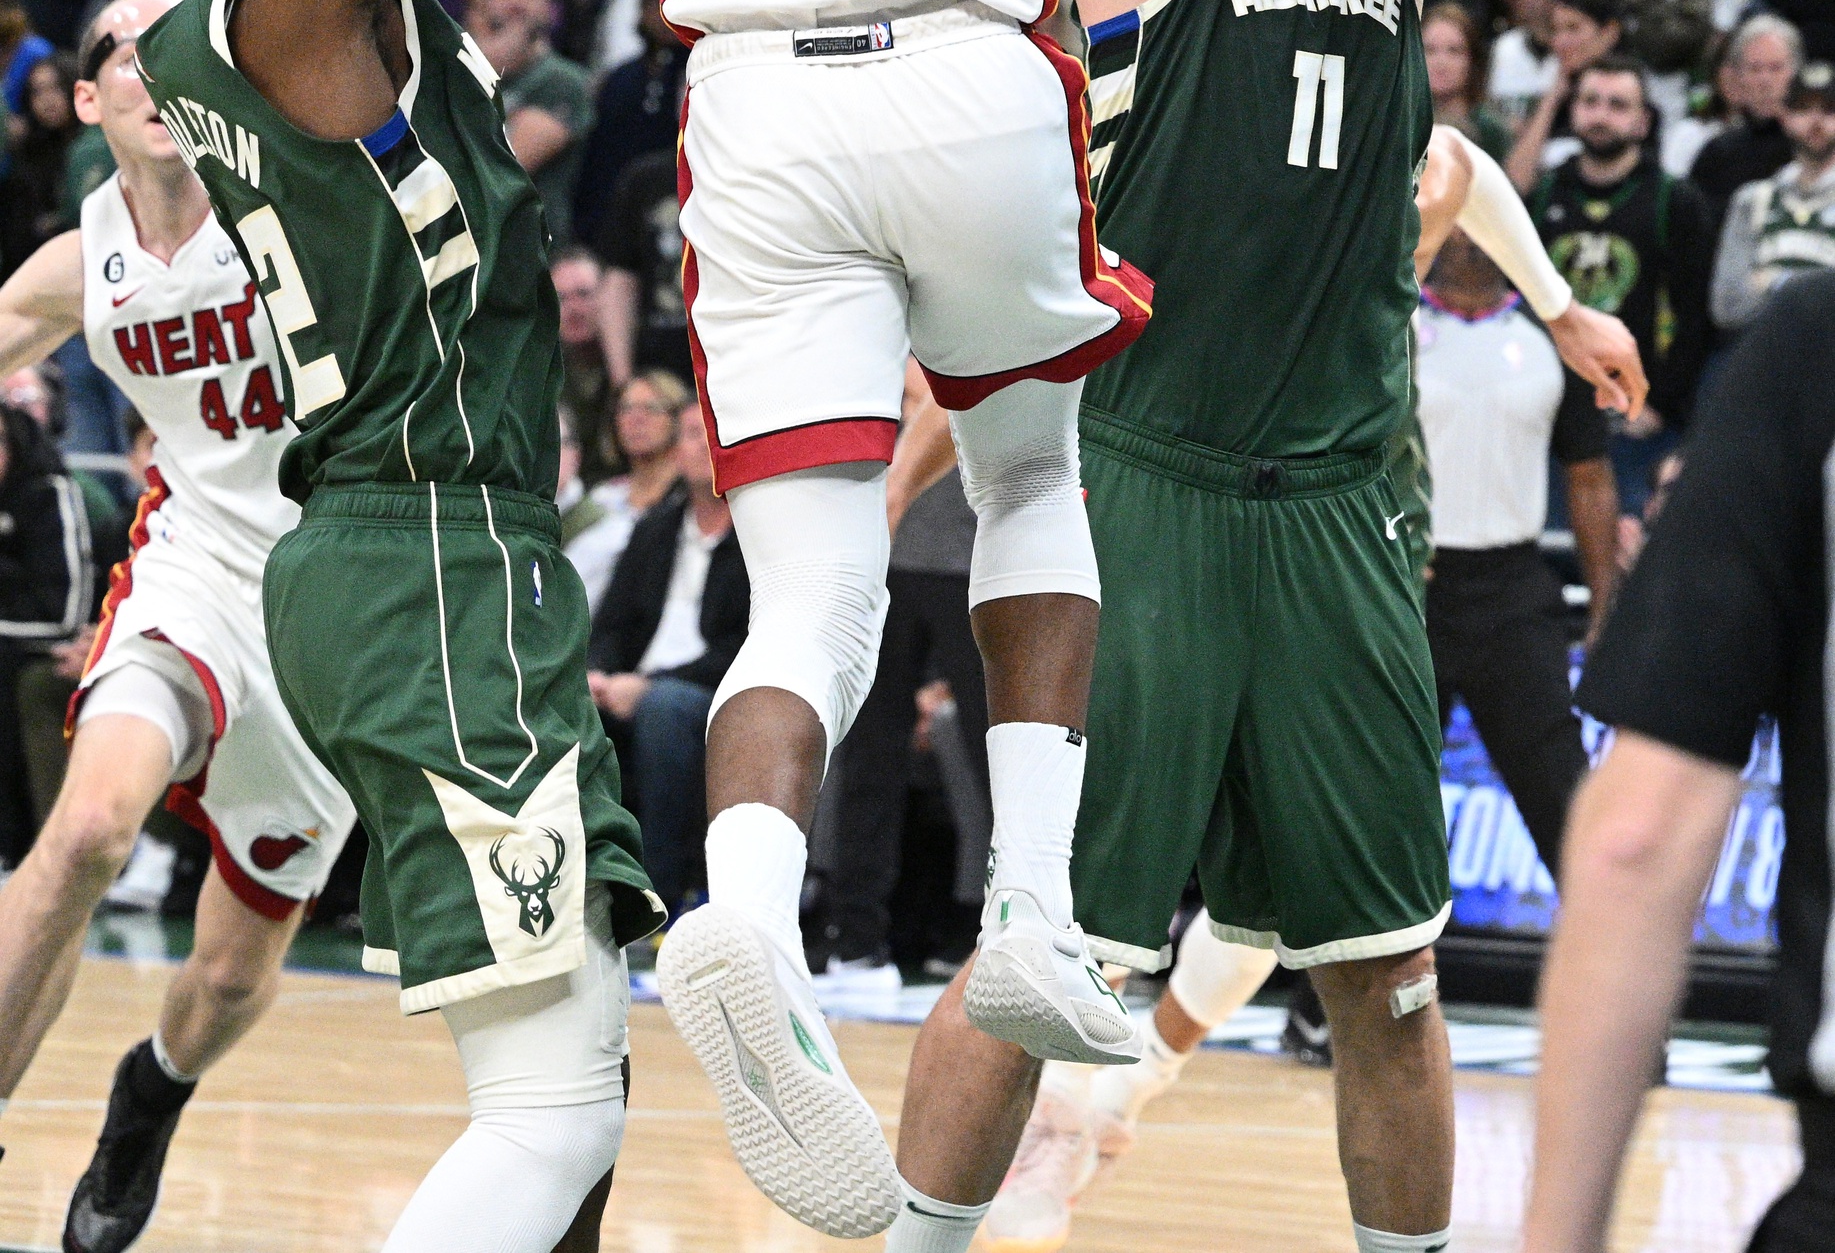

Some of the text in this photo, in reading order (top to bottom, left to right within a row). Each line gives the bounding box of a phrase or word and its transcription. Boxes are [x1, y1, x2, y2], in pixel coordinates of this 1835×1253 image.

[160, 96, 260, 189] DLETON
[1287, 50, 1345, 170] 11
[113, 280, 258, 377] HEAT
[236, 204, 347, 421] 2
[201, 363, 286, 441] 44
